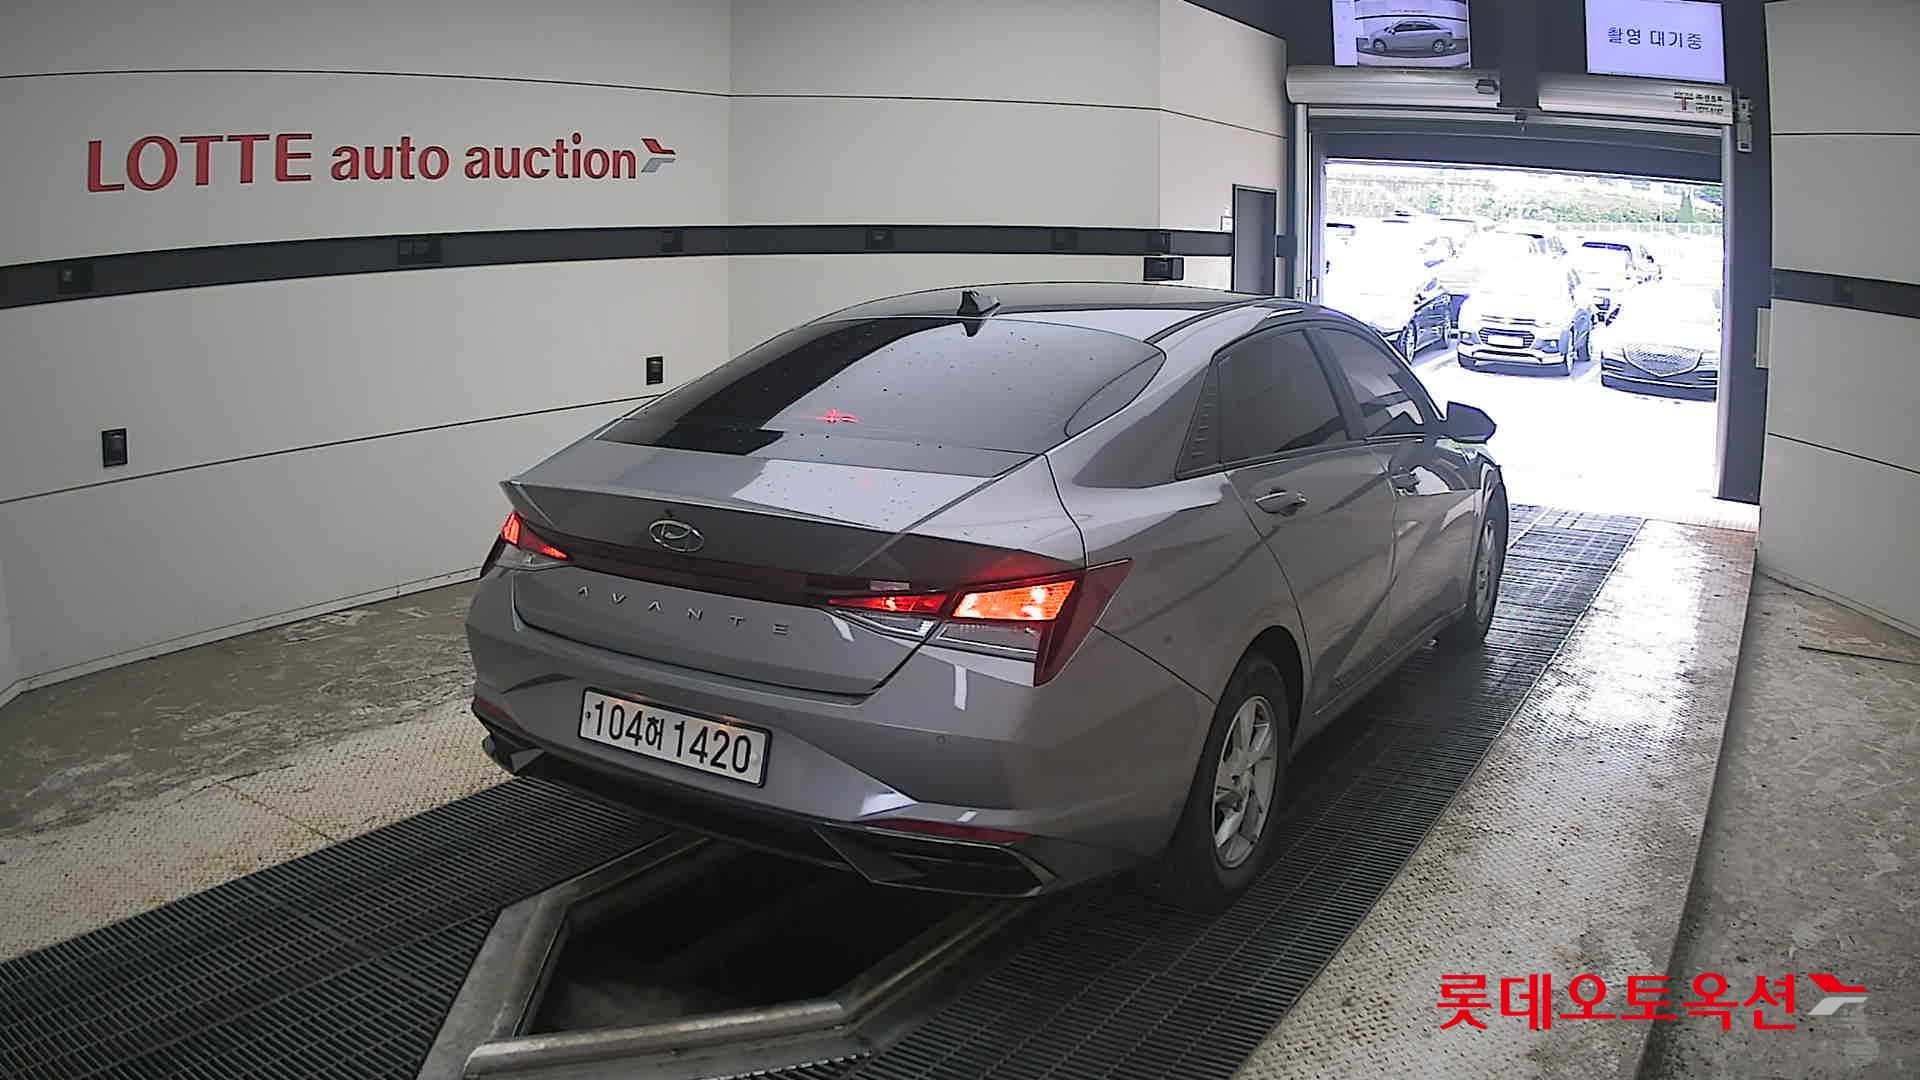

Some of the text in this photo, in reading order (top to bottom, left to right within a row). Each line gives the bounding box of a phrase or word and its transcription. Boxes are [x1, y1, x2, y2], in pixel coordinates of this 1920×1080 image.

[88, 132, 637, 193] LOTTE auto auction
[577, 585, 790, 637] AVANTE
[594, 700, 752, 774] 104허 1420
